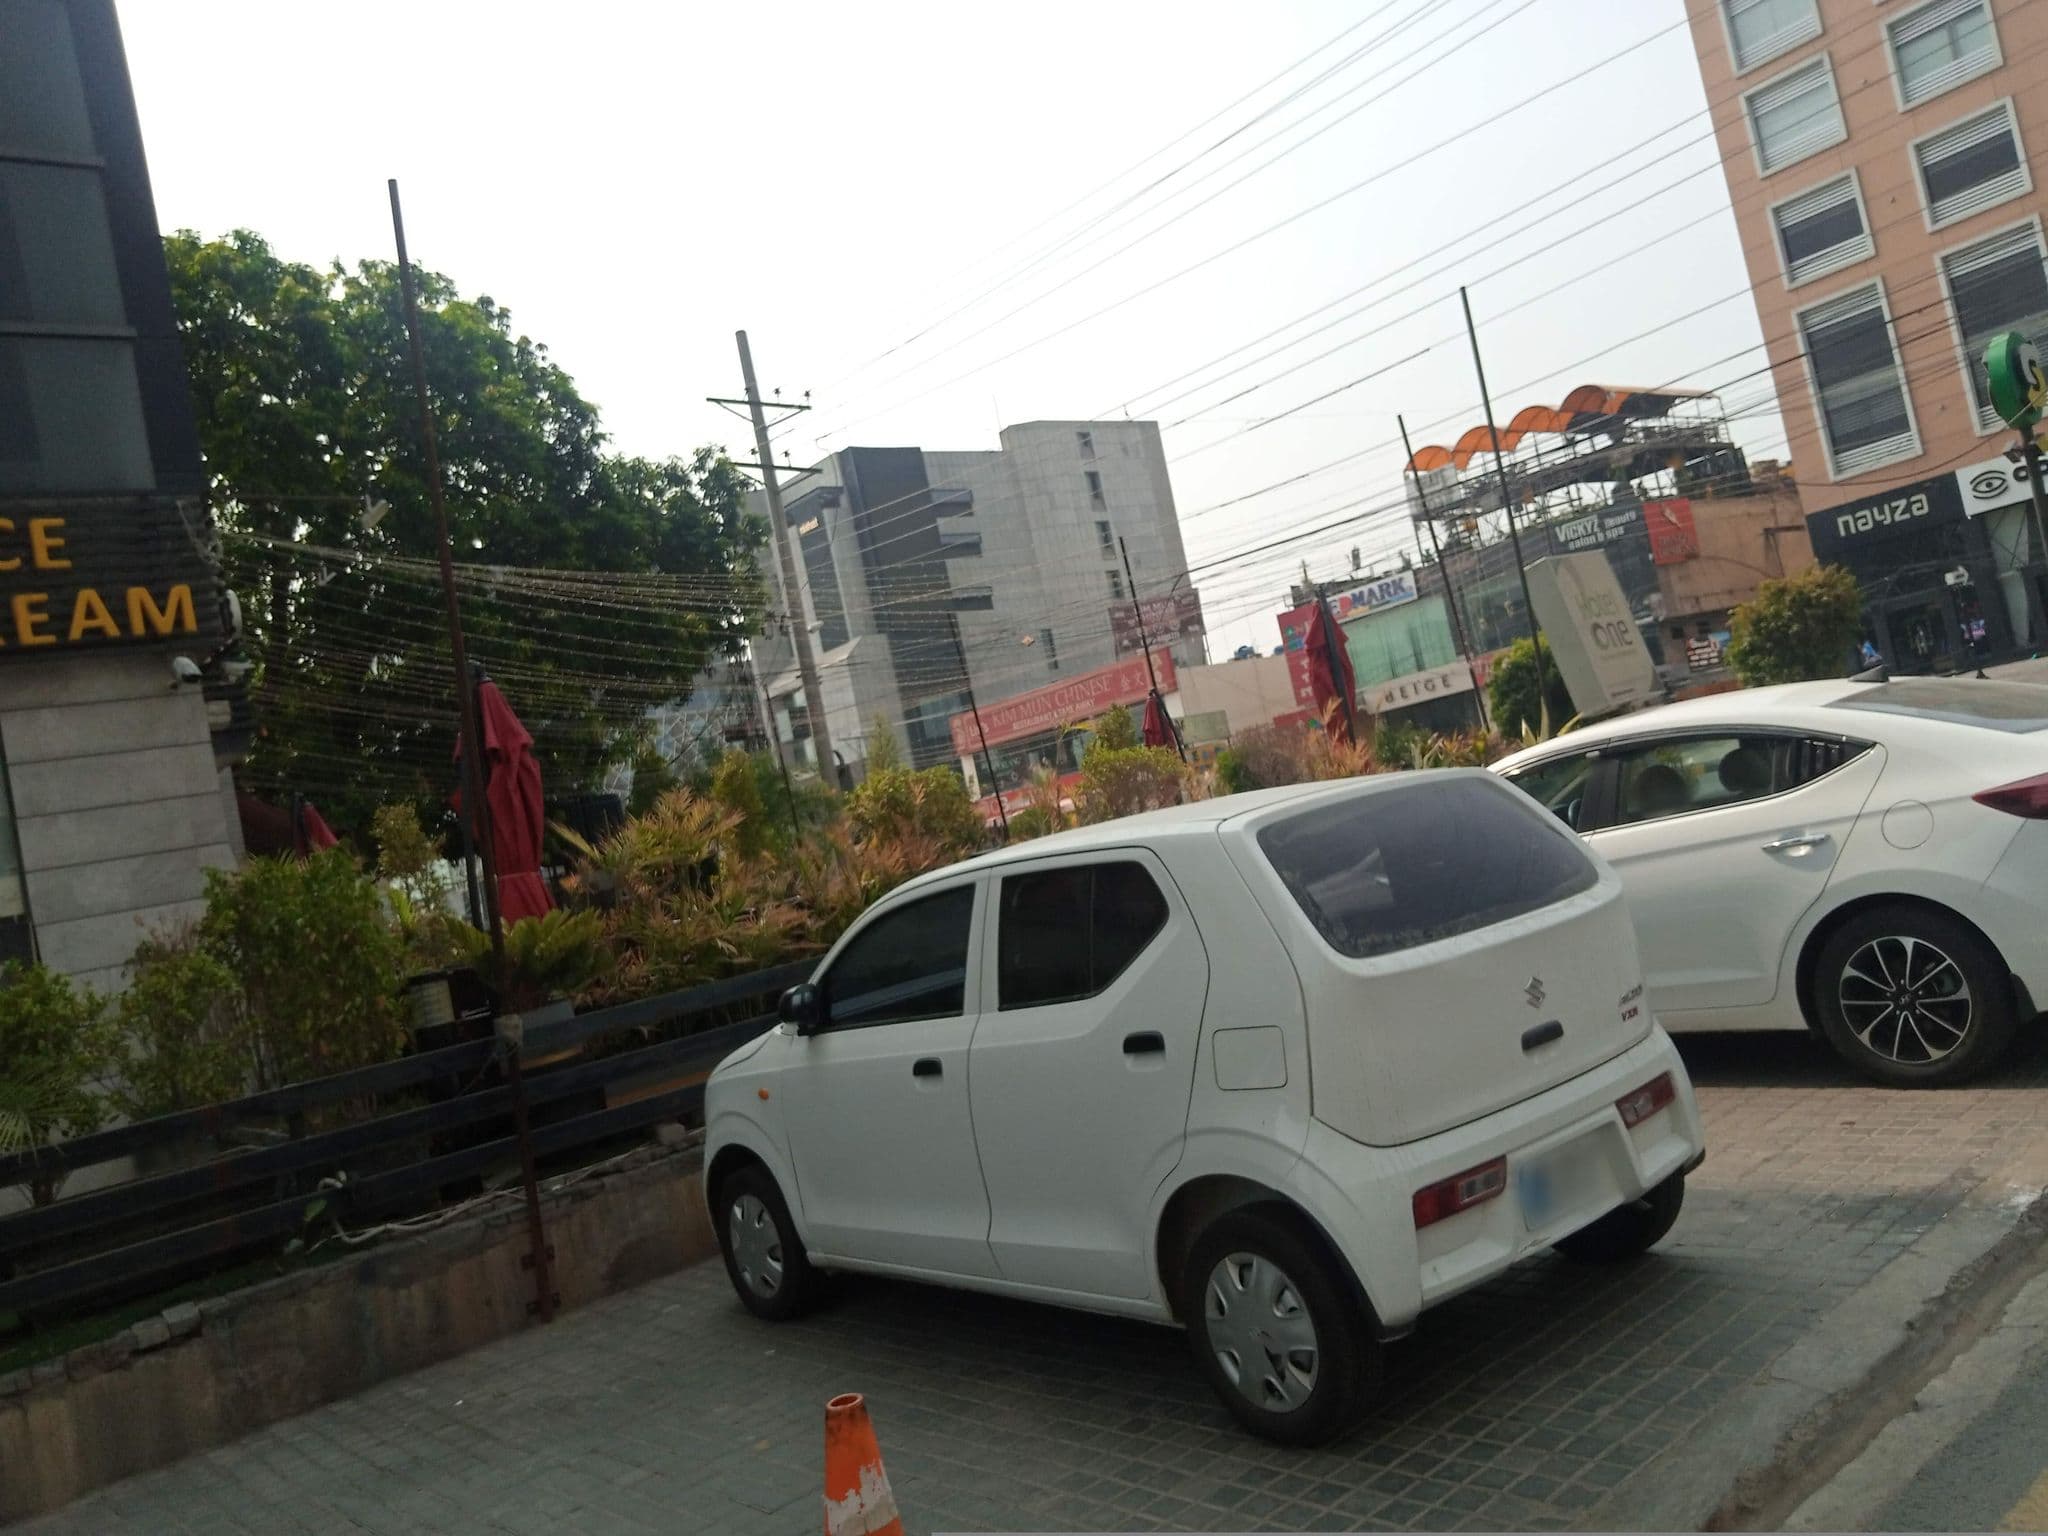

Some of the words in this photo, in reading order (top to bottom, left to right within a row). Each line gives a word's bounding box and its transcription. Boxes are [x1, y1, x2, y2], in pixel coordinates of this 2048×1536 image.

[1837, 494, 1929, 537] nayza
[0, 584, 198, 647] EAM
[992, 708, 1017, 728] KIM
[1018, 695, 1053, 722] MUN
[1056, 674, 1112, 706] CHINESE
